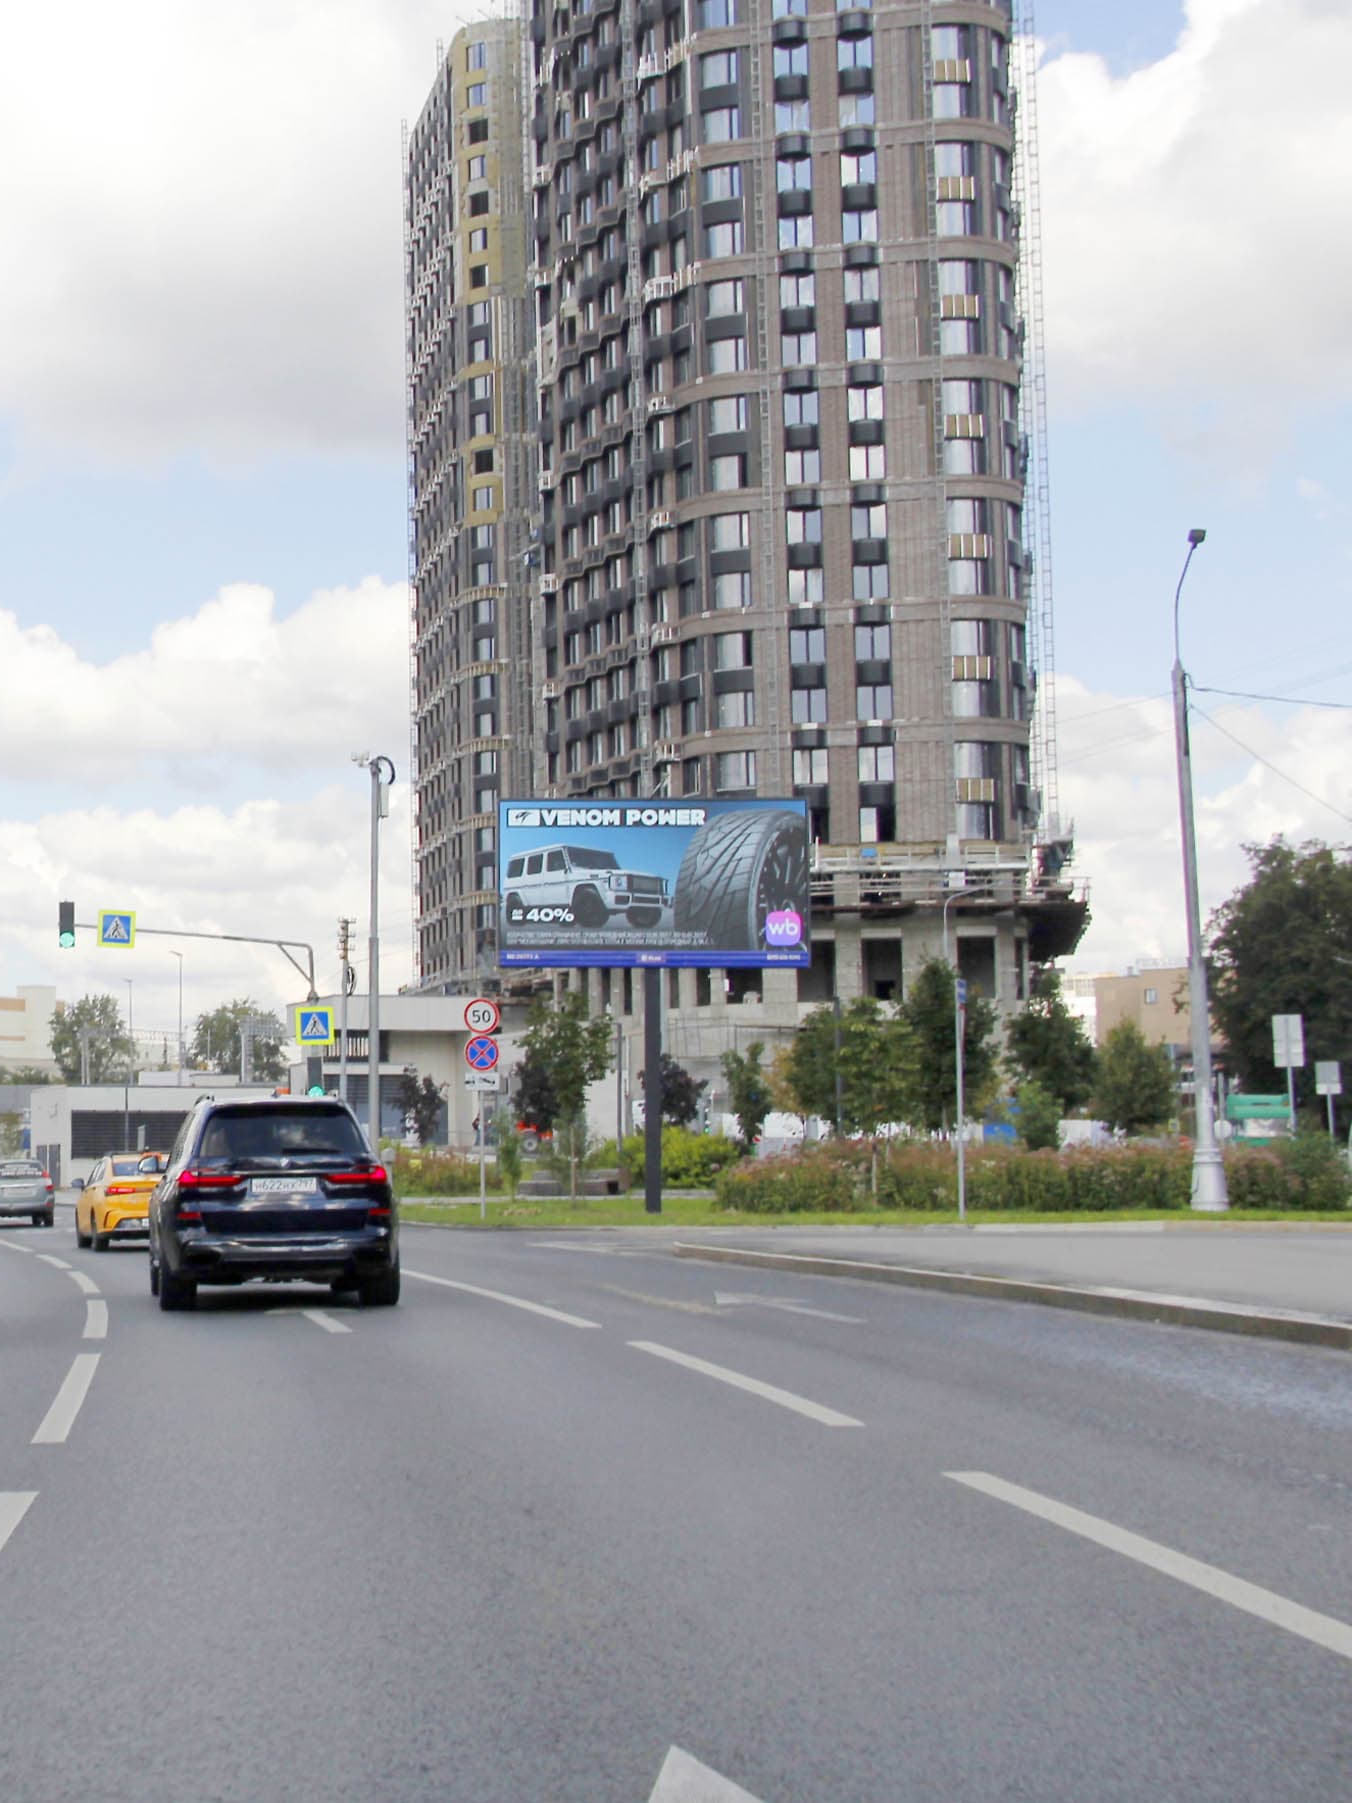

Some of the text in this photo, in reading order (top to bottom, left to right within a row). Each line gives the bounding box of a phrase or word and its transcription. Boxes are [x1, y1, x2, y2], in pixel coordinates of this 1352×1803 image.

[540, 808, 706, 826] VENOM POWER
[526, 907, 575, 922] 40%
[768, 918, 799, 936] wb
[472, 1009, 491, 1024] 50
